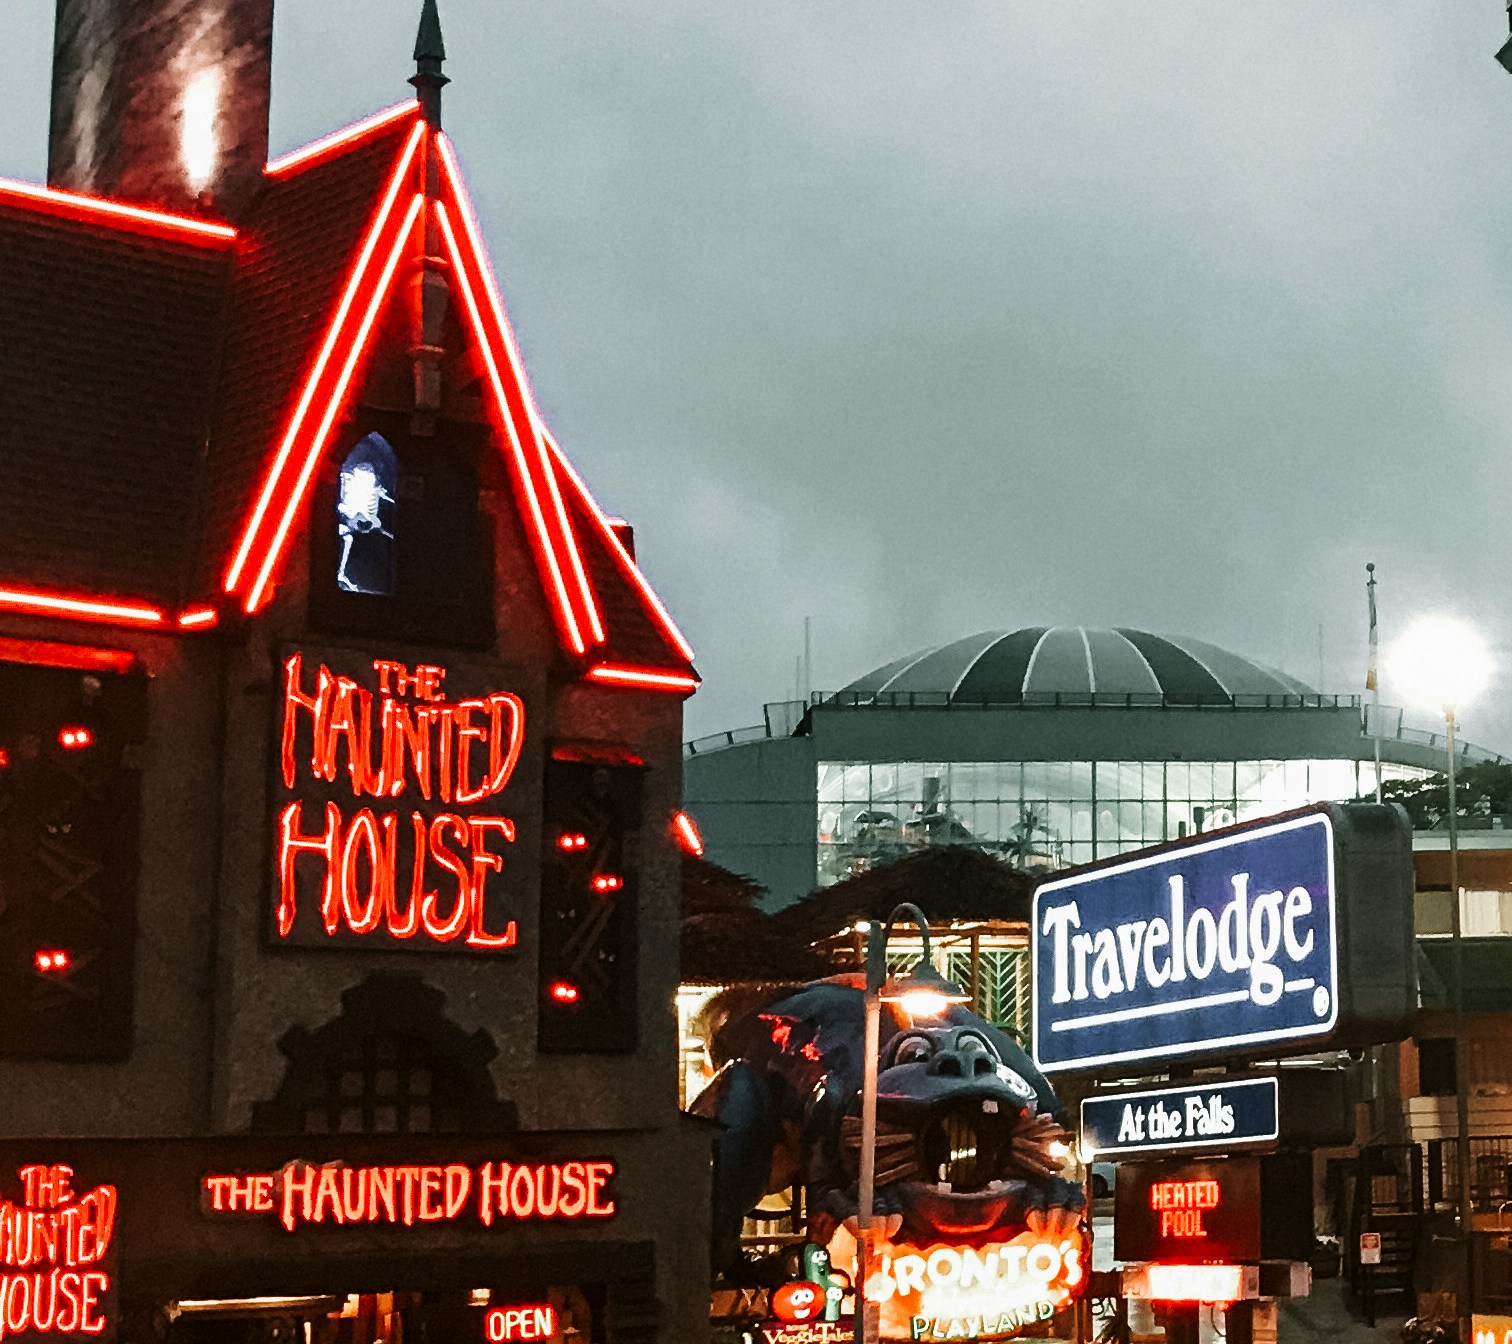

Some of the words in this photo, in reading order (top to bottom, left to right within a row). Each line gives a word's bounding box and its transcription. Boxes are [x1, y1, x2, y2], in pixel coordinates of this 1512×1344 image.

[373, 659, 446, 702] THE
[281, 652, 525, 804] HAUNTED
[275, 800, 517, 950] HOUSE
[1043, 872, 1314, 1007] Travelodge
[1117, 1102, 1145, 1142] At
[1148, 1100, 1182, 1139] the
[1185, 1094, 1235, 1137] Falls
[18, 1165, 75, 1208] THE
[206, 1176, 275, 1211] THE
[281, 1162, 472, 1232] HAUNTED
[479, 1161, 615, 1228] HOUSE
[1151, 1180, 1220, 1209] HEATED
[0, 1184, 117, 1268] AUNTED
[1161, 1210, 1208, 1238] POOL
[488, 1307, 553, 1342] OPEN
[911, 1300, 1055, 1340] PLAYLAND
